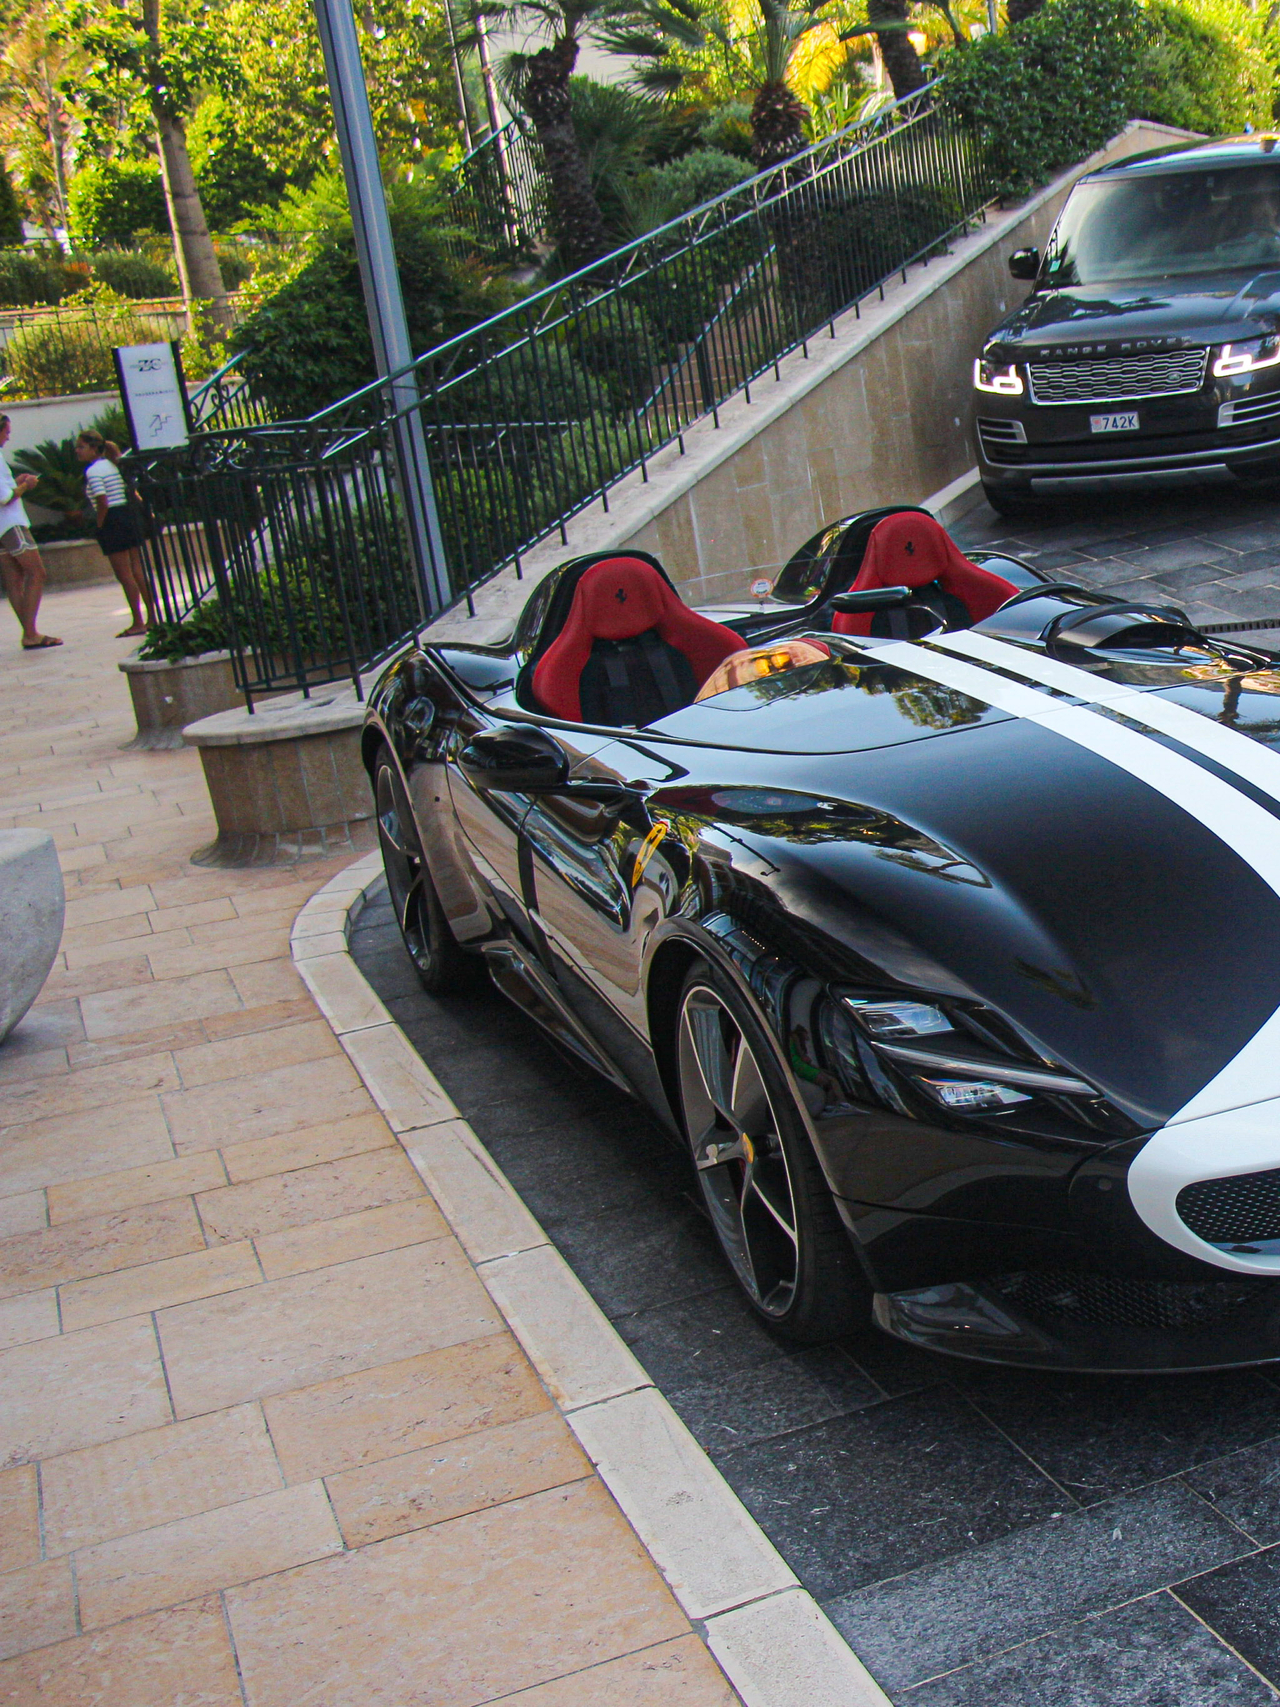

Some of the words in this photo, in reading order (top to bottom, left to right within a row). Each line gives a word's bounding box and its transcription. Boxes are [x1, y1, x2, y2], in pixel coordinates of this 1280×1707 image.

[1040, 345, 1106, 357] RANGE
[1121, 336, 1191, 350] ROVER
[1102, 415, 1136, 430] 742K
